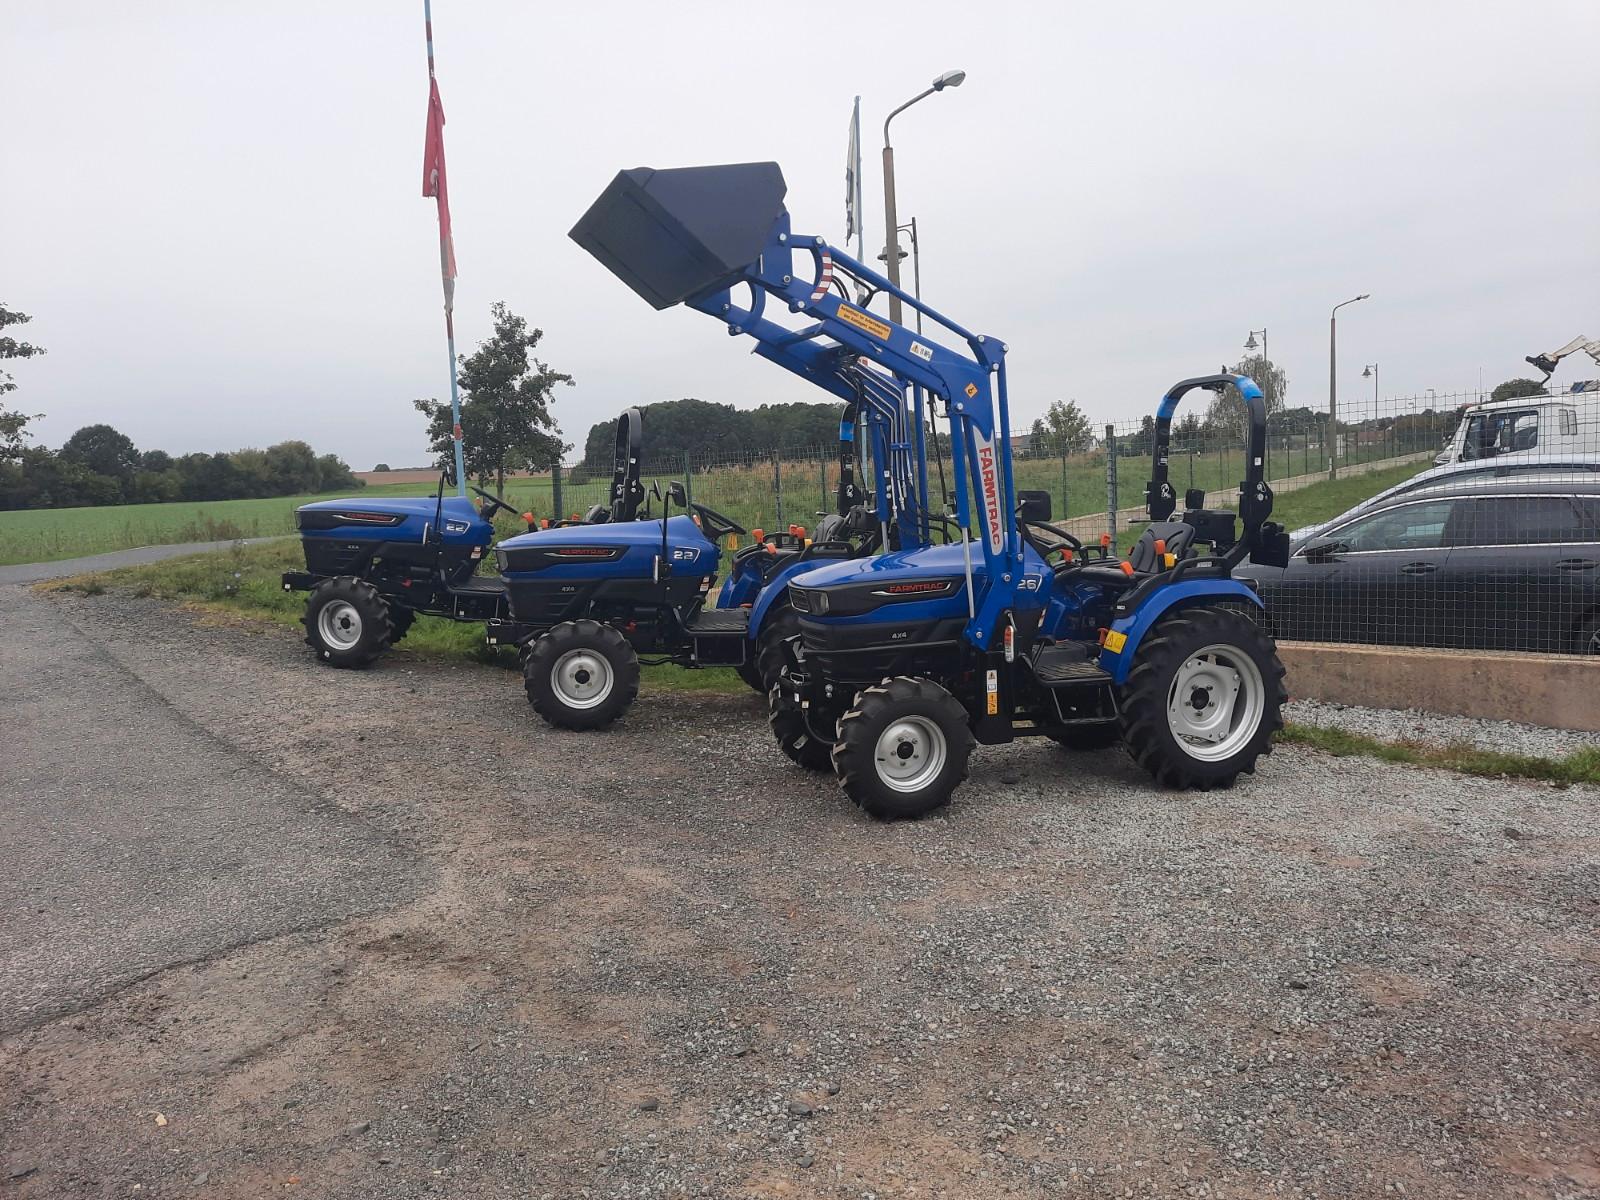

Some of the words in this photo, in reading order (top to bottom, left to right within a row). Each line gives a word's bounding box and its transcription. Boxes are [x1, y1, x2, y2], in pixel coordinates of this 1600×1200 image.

[979, 447, 1001, 545] FARMTRAC
[446, 523, 465, 532] 22
[673, 550, 694, 560] 22
[889, 583, 944, 593] FARMTRAC
[1017, 579, 1037, 590] 26
